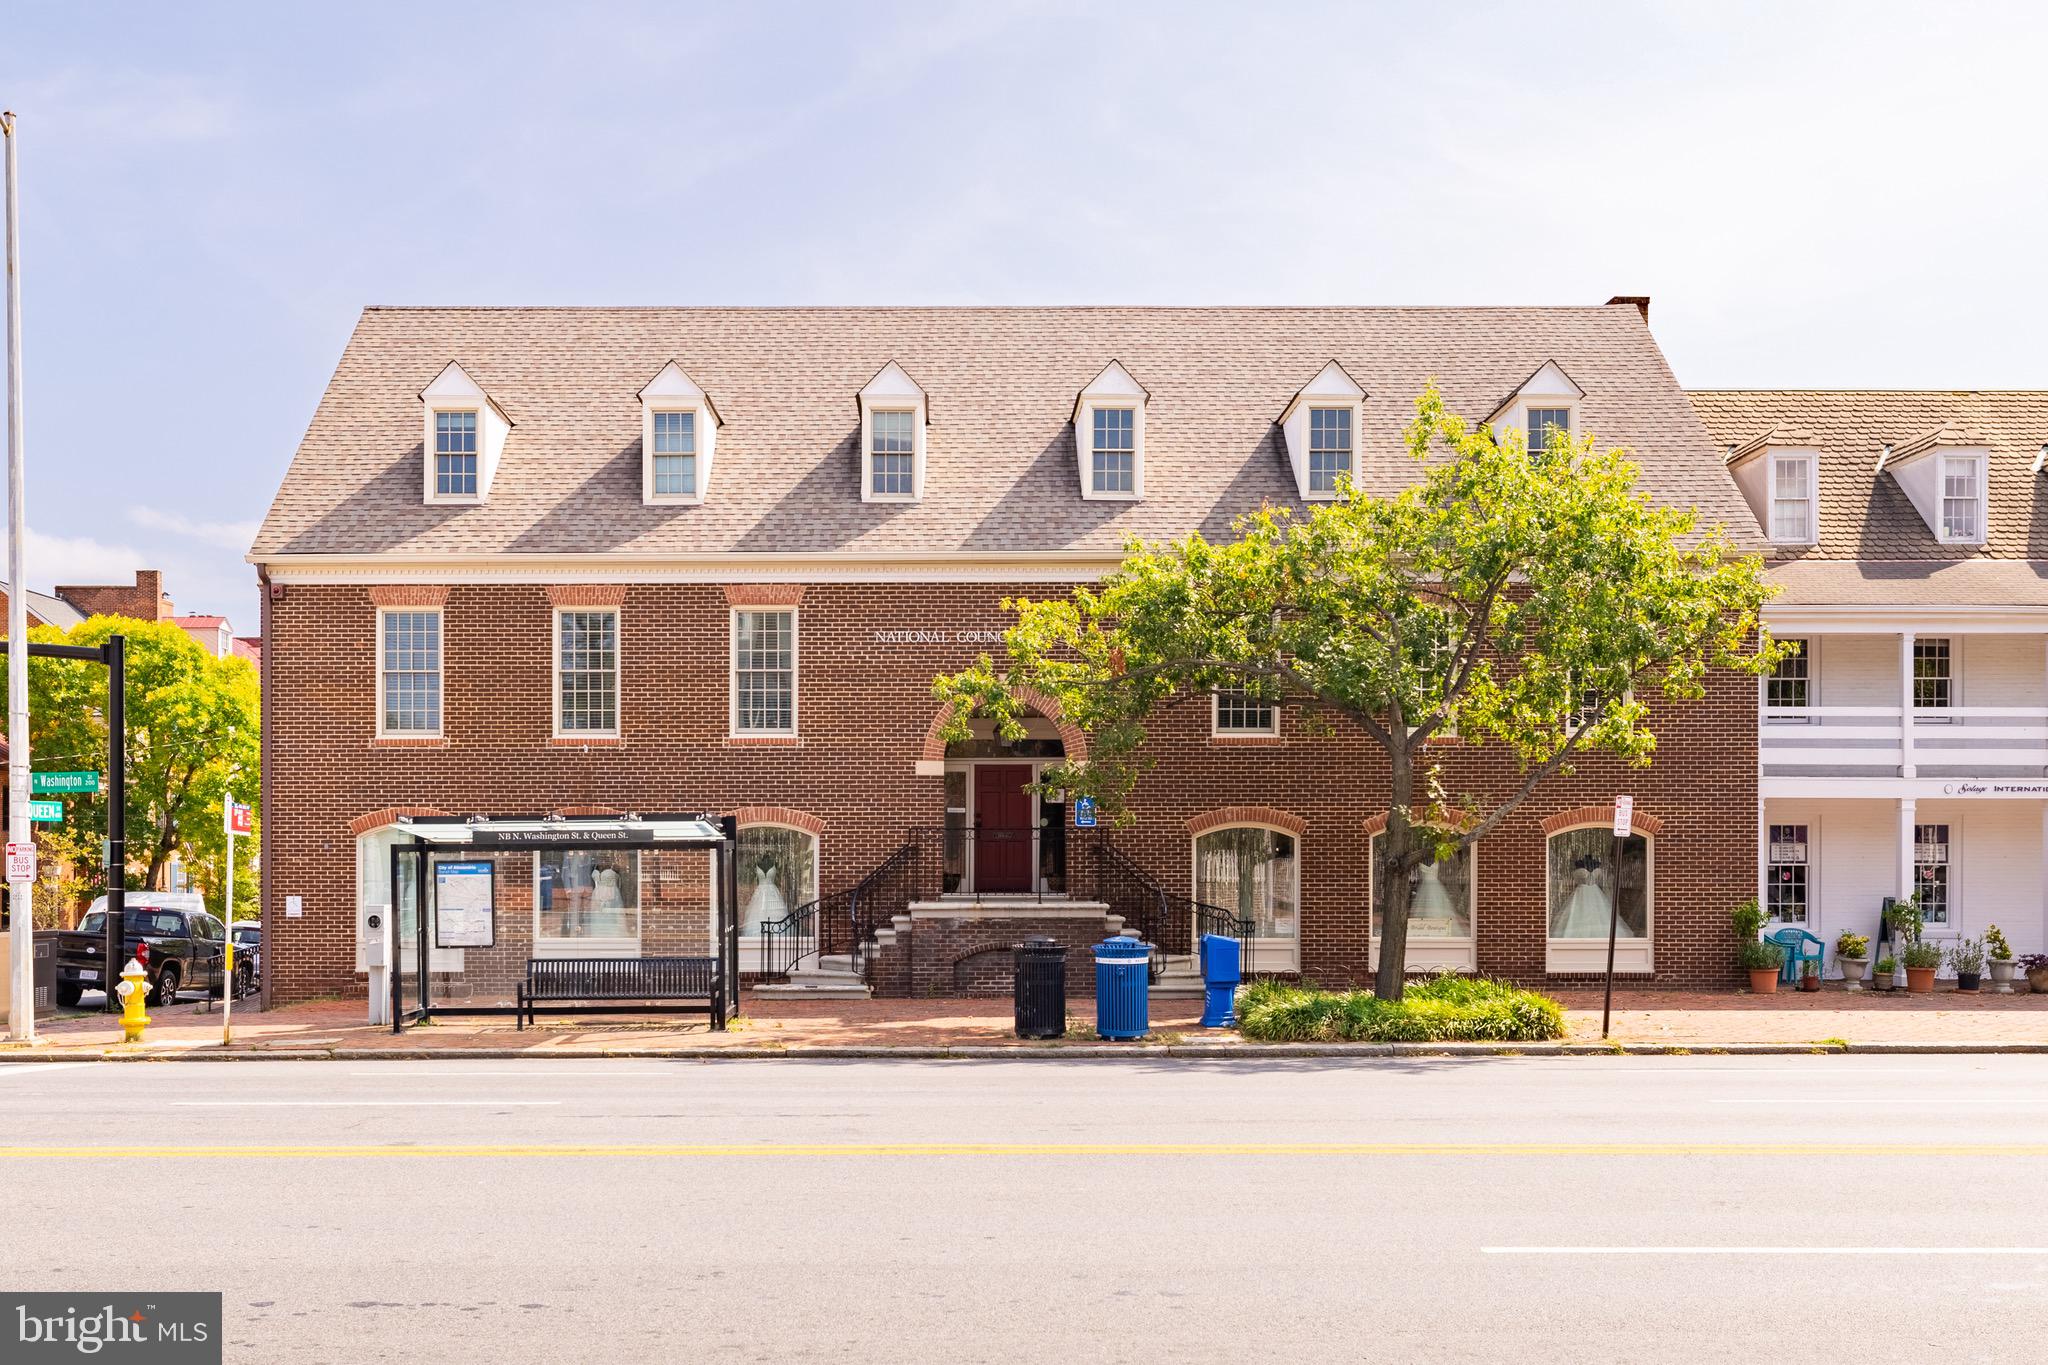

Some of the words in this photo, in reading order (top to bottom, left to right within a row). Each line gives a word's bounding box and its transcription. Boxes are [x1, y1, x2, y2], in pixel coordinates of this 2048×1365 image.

[875, 630, 950, 643] NATIONAL
[40, 774, 82, 790] Washington
[498, 832, 511, 840] NB
[512, 832, 522, 840] N.
[523, 831, 570, 841] Washington
[571, 831, 582, 840] St.
[583, 831, 590, 840] &
[591, 831, 617, 841] Queen
[618, 831, 629, 839] St.
[13, 856, 29, 864] BUS
[11, 864, 31, 872] STOP
